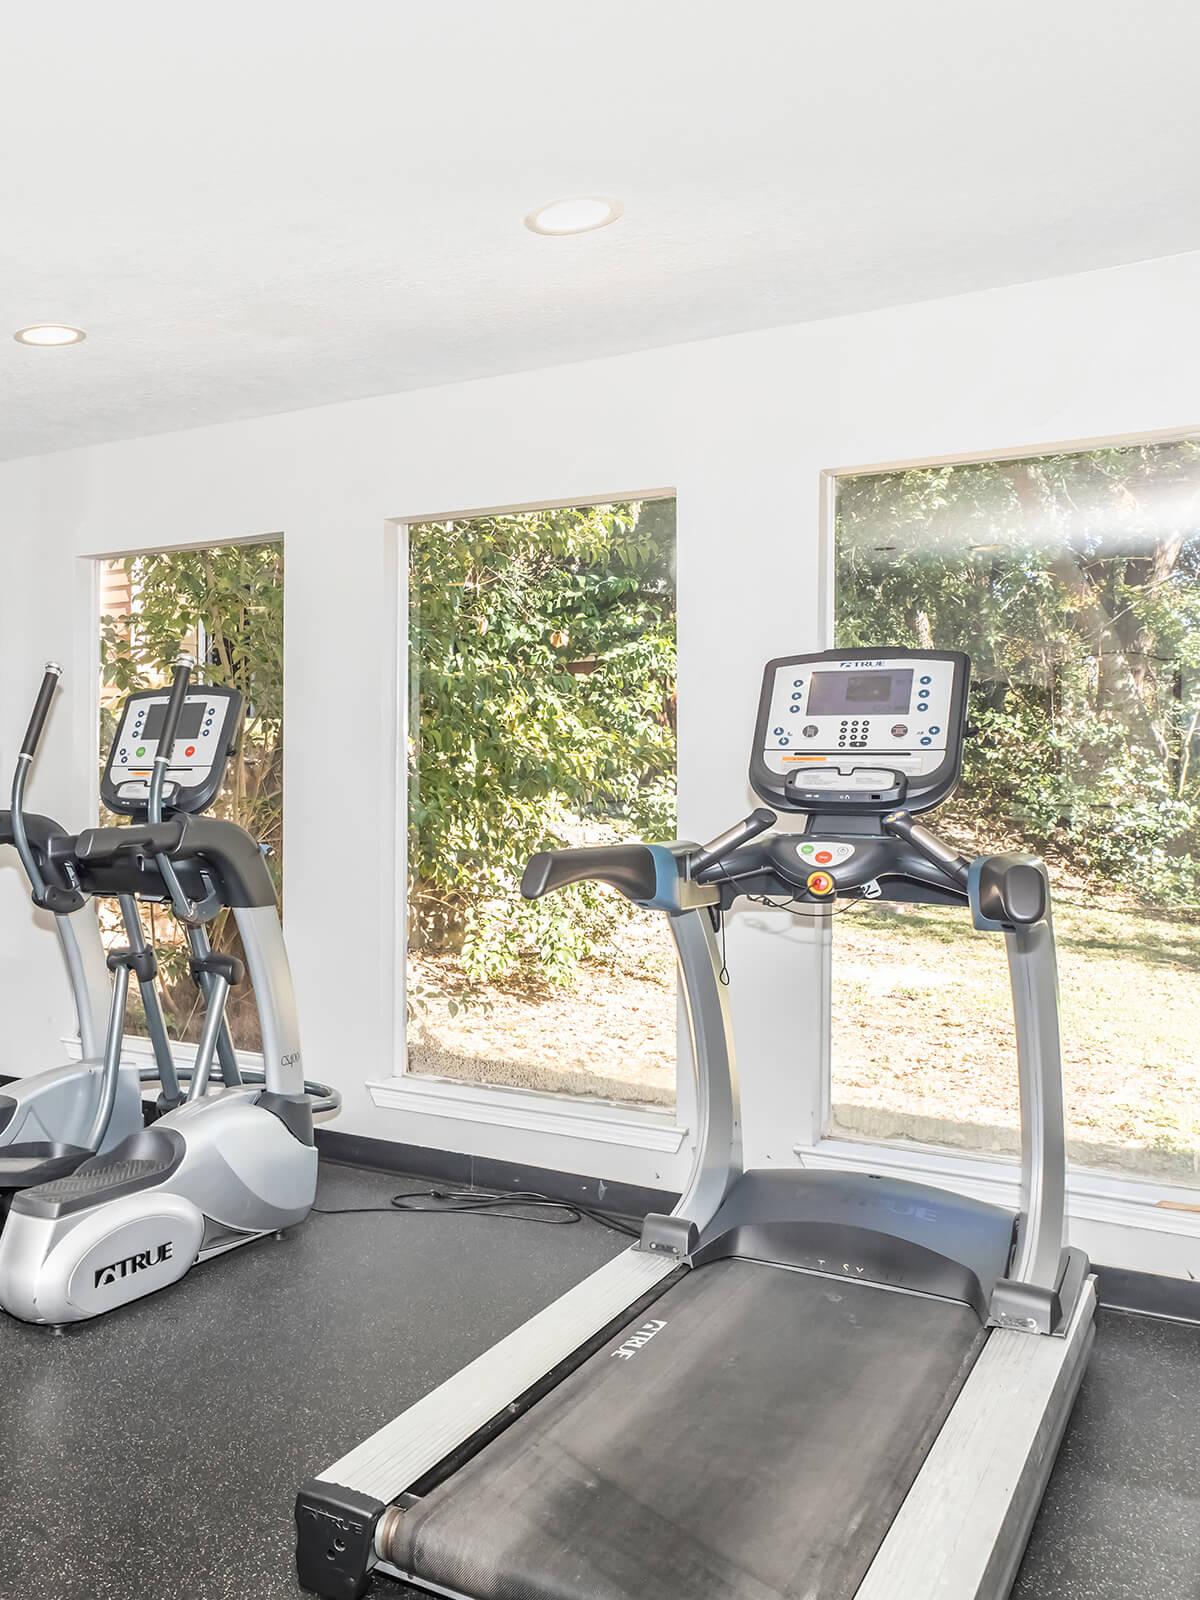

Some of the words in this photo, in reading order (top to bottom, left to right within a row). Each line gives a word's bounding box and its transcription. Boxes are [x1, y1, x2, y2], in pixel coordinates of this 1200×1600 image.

[853, 660, 886, 668] TRUE
[114, 1240, 173, 1279] TRUE
[610, 1330, 658, 1361] TRUE
